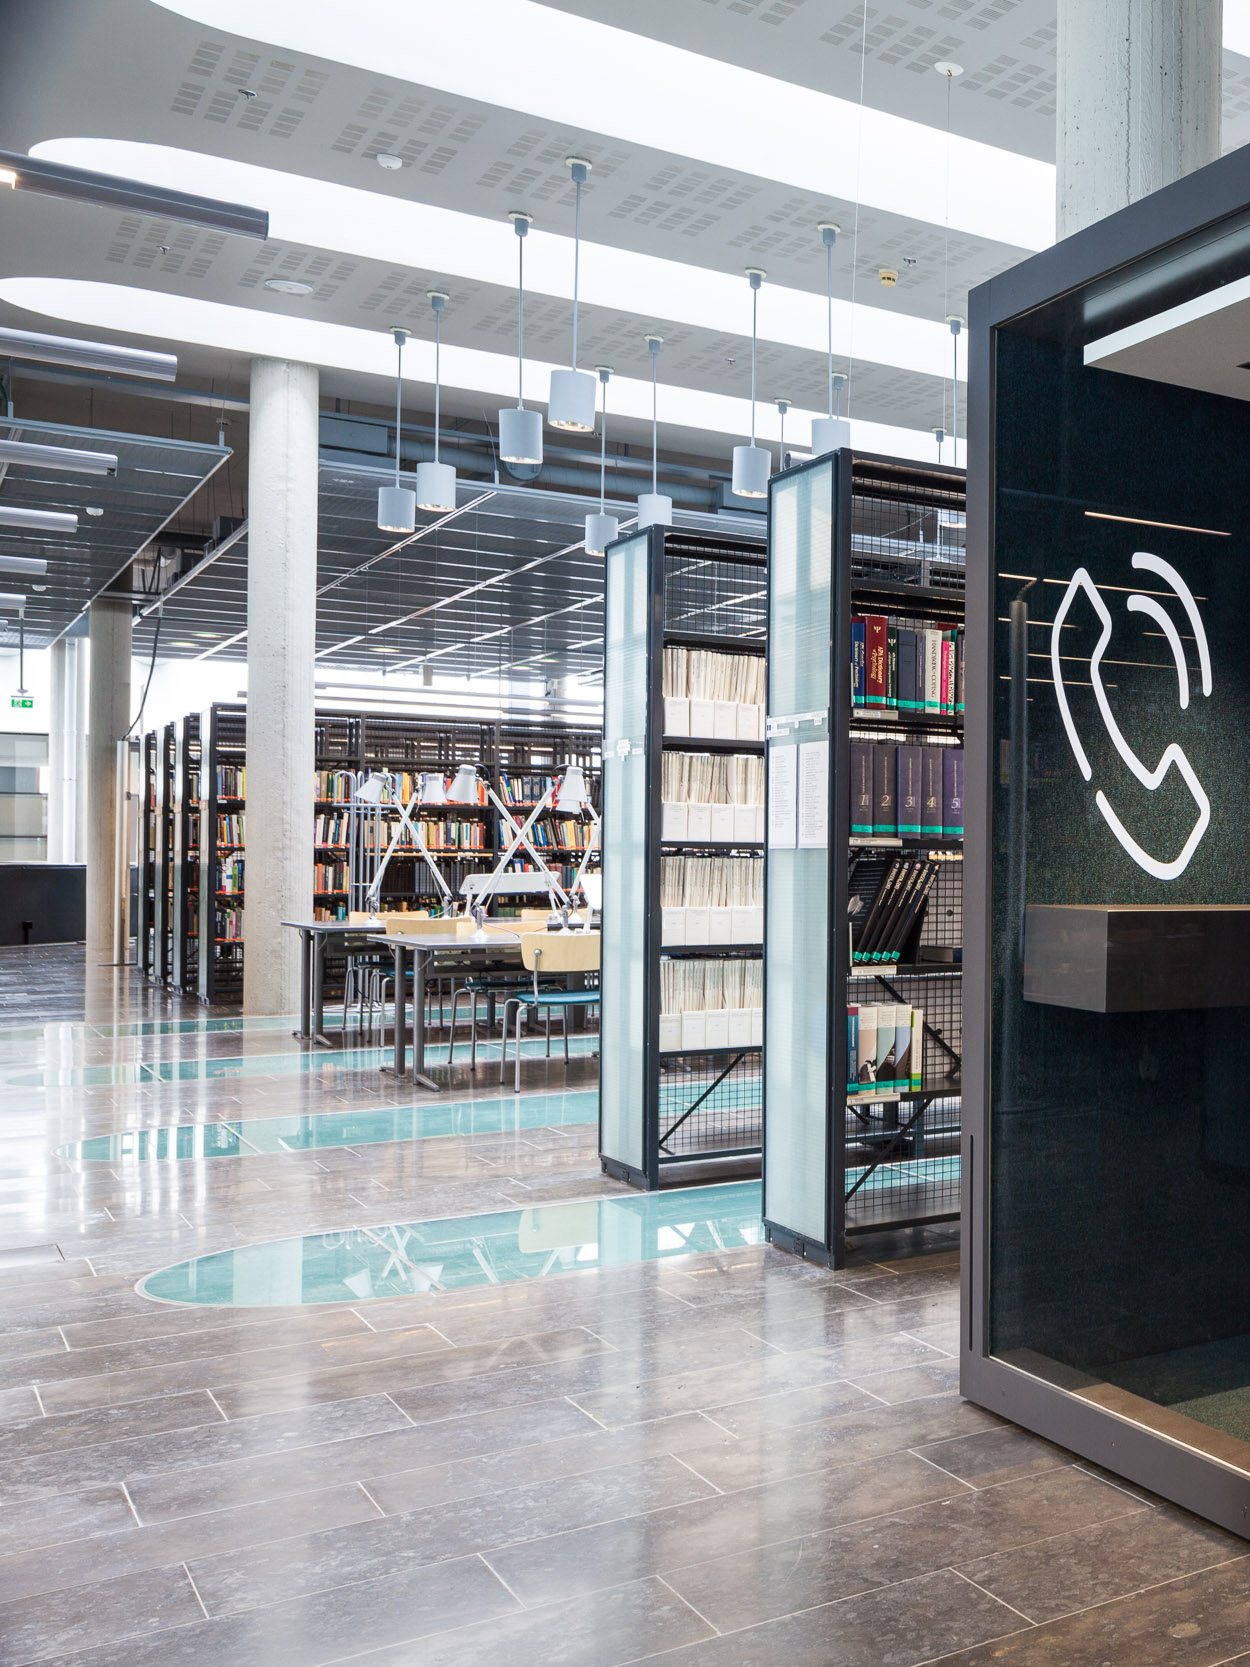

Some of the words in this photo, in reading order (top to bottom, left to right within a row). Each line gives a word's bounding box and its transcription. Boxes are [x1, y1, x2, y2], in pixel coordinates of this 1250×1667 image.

[870, 652, 878, 681] Psychology
[860, 794, 866, 806] 1
[881, 794, 890, 807] 2
[905, 795, 913, 808] 3
[926, 796, 935, 808] 4
[951, 797, 960, 809] 5
